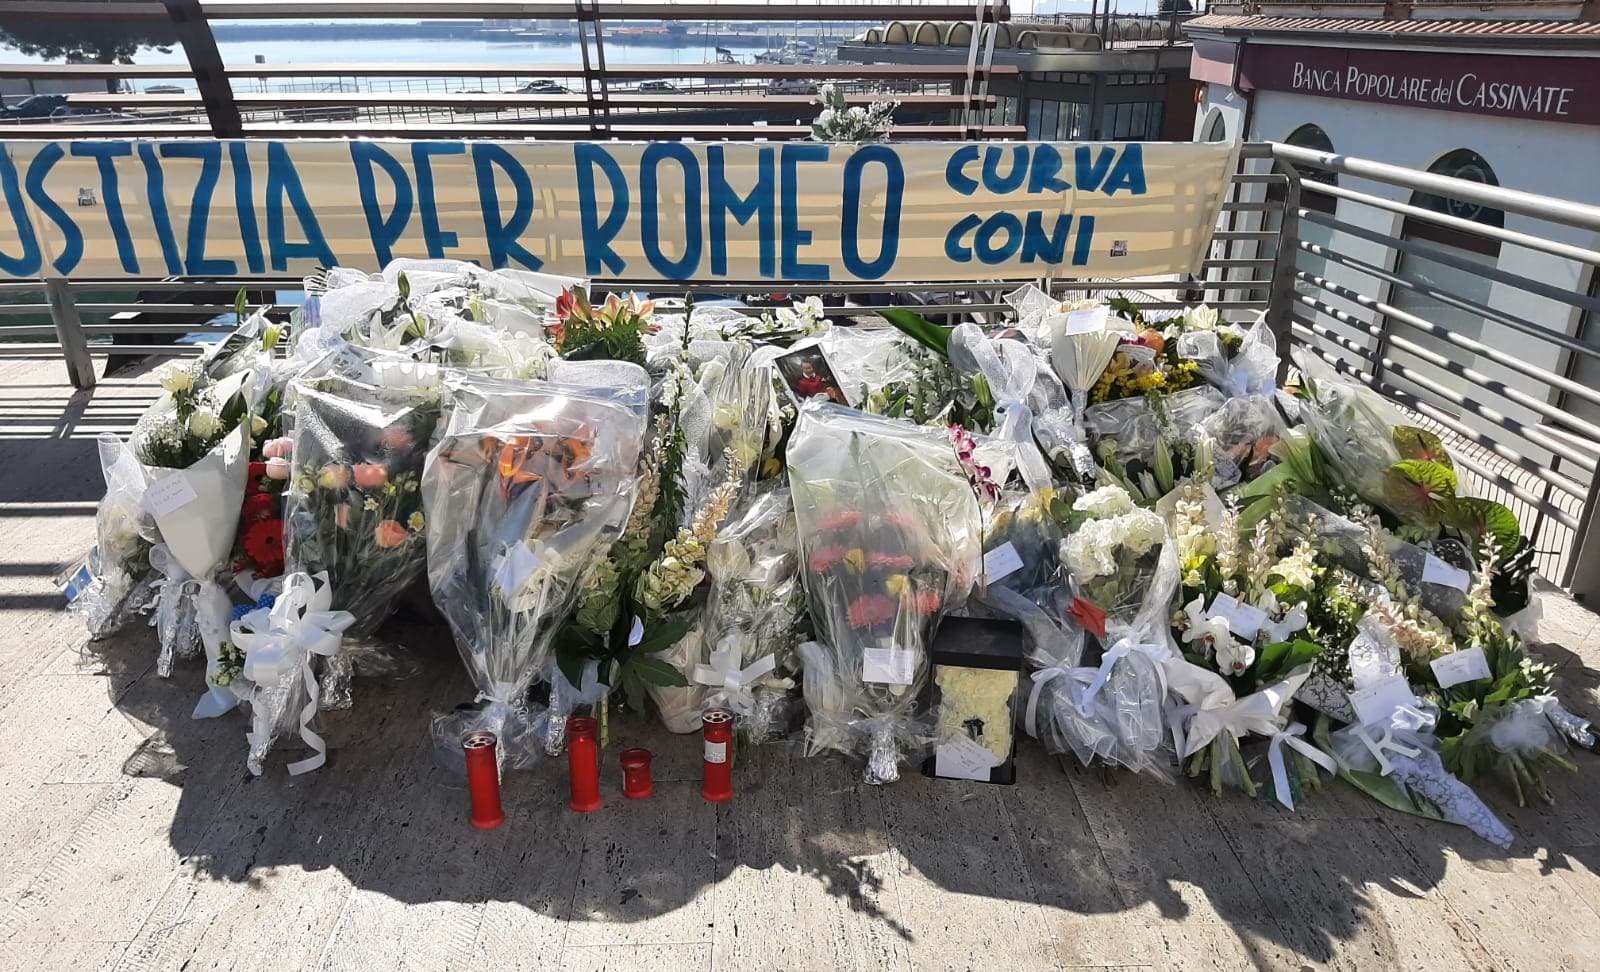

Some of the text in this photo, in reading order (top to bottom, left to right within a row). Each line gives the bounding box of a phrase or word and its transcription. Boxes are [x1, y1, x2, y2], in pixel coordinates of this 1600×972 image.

[1292, 62, 1574, 115] BANCA POPOLARE del CASSINATE
[946, 143, 1147, 195] CURVA
[350, 141, 544, 273] PER
[575, 142, 905, 282] ROMEO
[945, 211, 1094, 266] CONI
